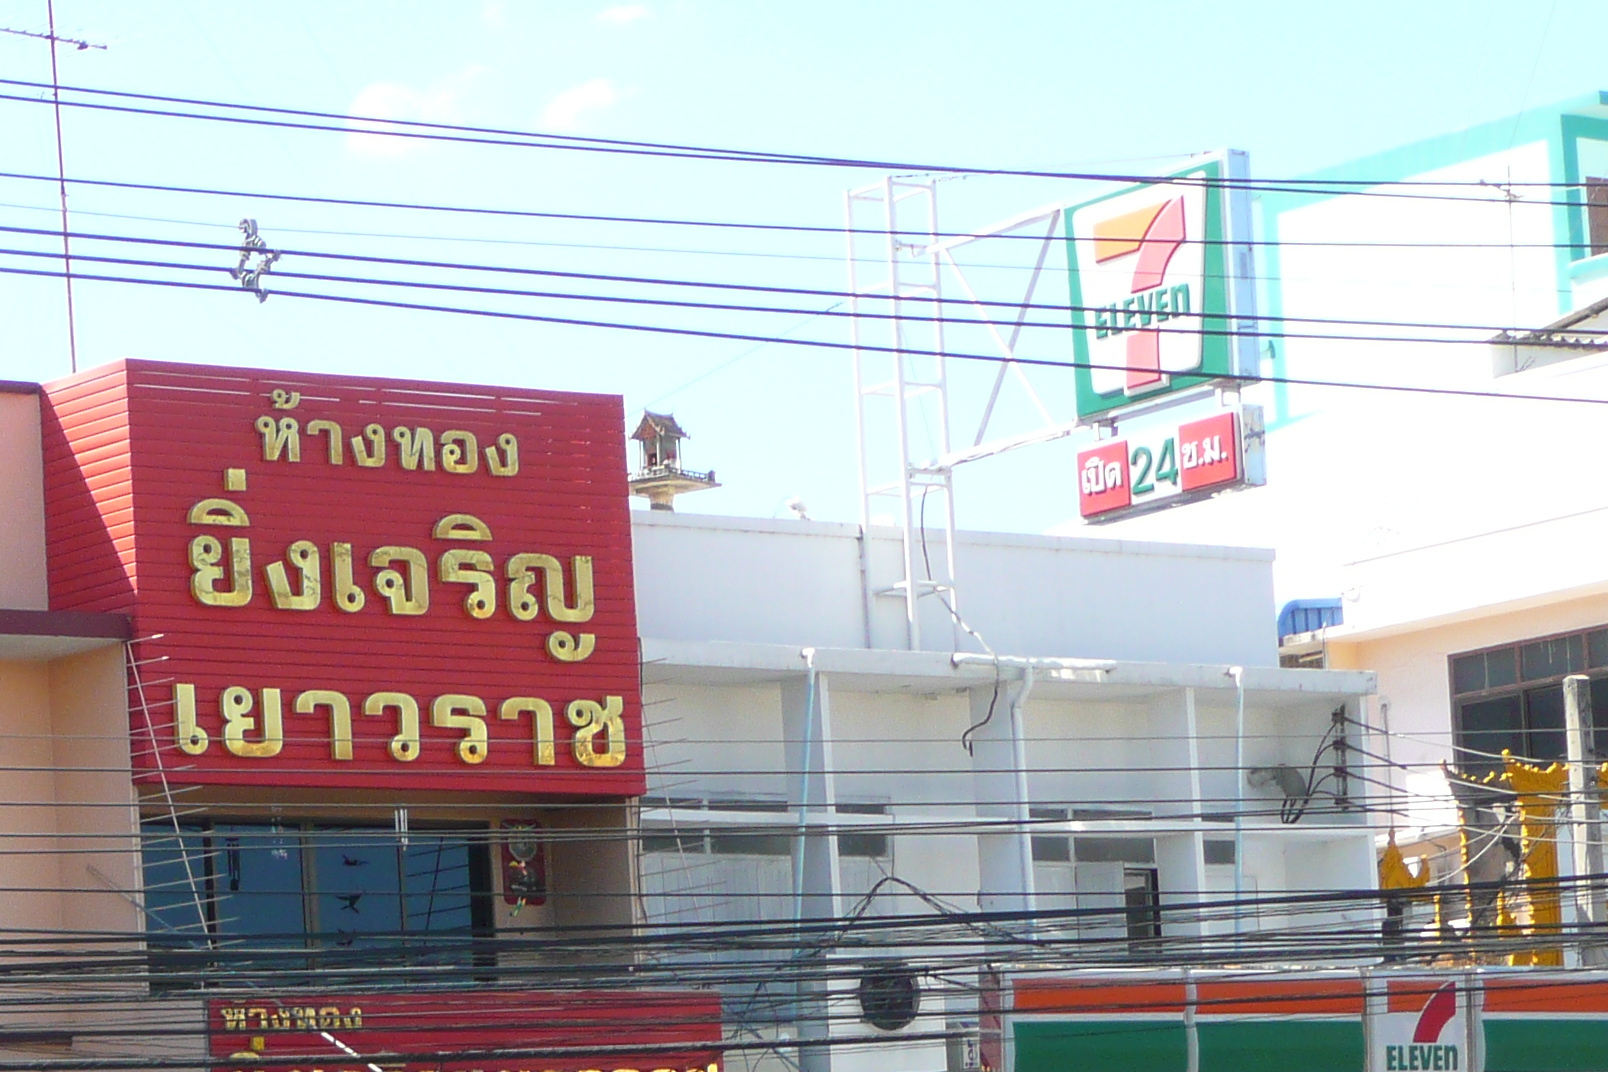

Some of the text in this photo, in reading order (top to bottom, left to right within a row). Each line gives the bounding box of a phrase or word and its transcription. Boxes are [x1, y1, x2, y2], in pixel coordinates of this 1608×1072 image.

[255, 389, 519, 477] ห้างทอง
[1081, 455, 1123, 495] เปิด
[1130, 437, 1180, 495] 24
[187, 467, 596, 662] ยิ่งเจริญ
[173, 682, 626, 768] เยาวราช
